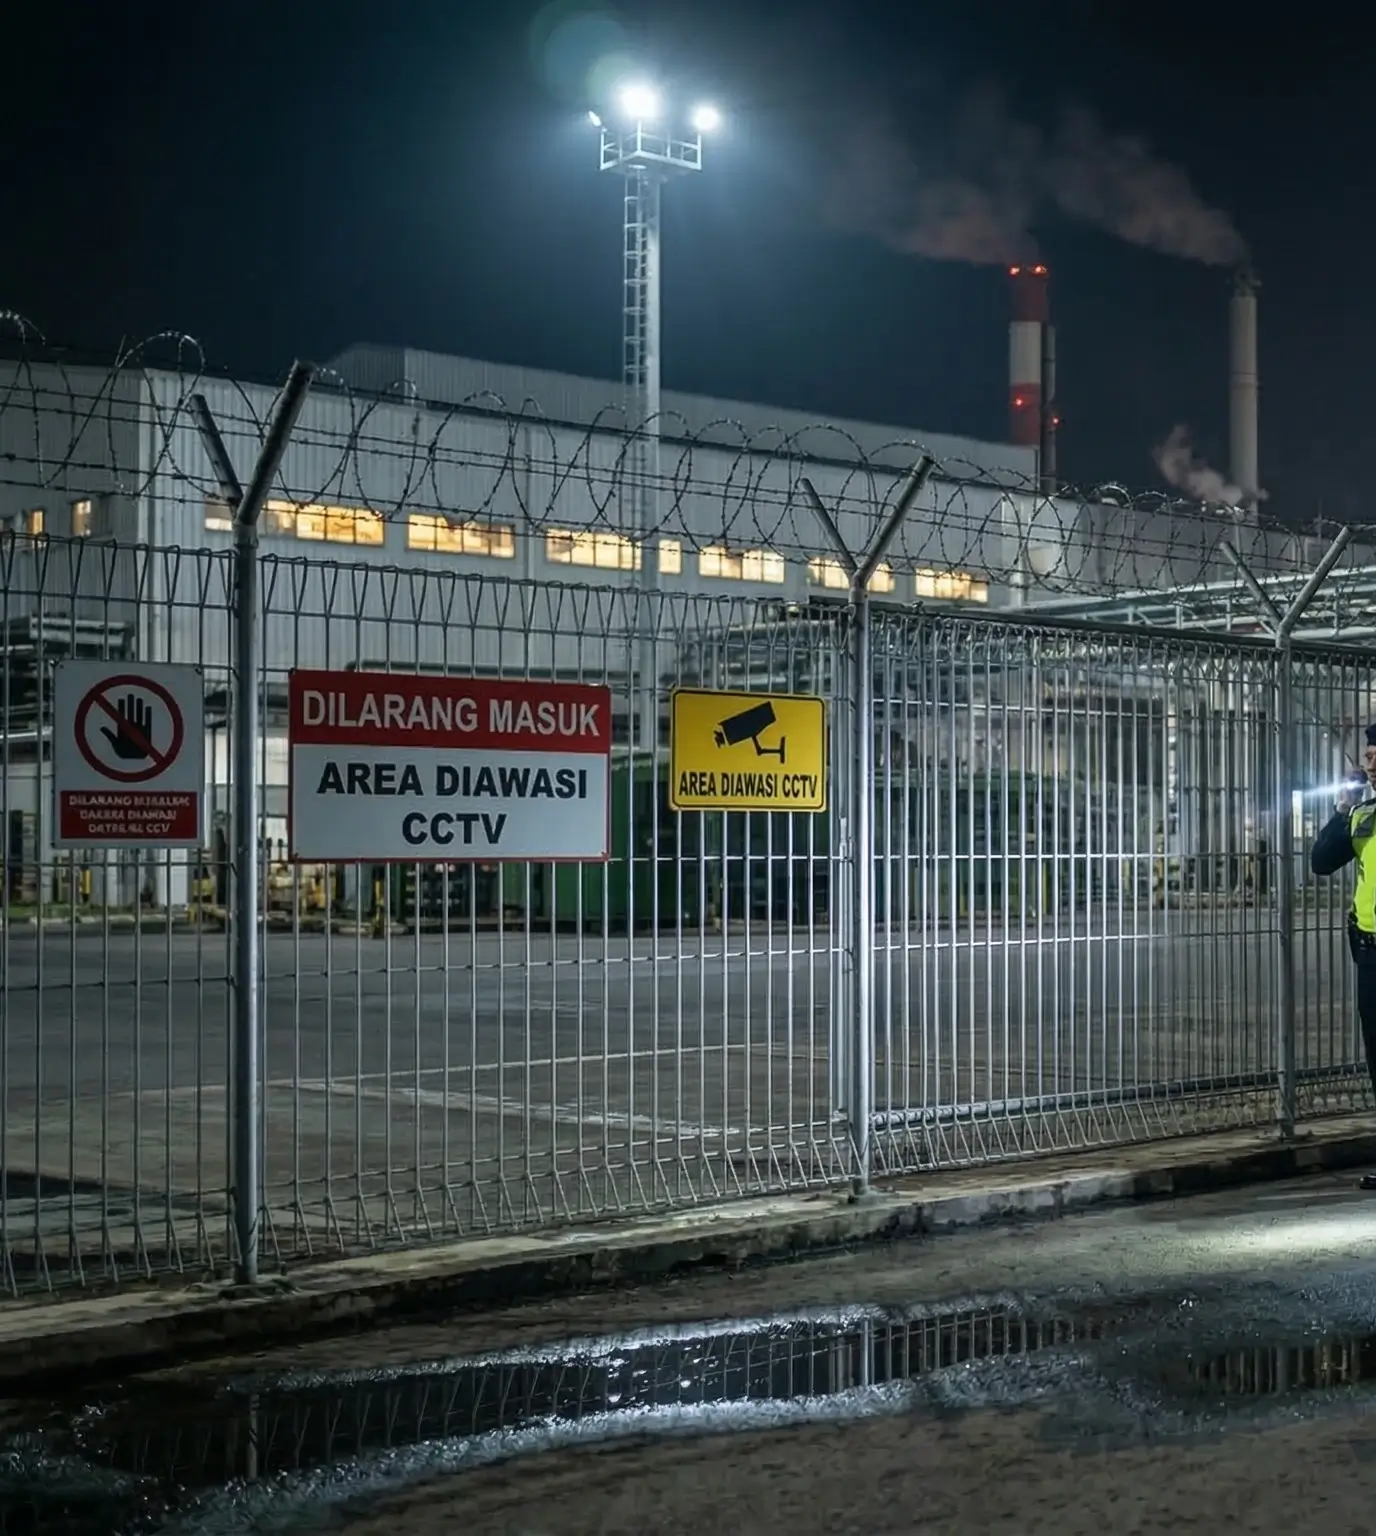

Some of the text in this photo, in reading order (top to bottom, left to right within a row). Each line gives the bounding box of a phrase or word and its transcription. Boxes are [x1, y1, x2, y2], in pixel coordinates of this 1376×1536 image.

[303, 690, 600, 737] DILARANG MASUK
[316, 762, 588, 799] AREA DIAWASI
[679, 770, 817, 798] AREA DIAWASI CCTV
[402, 812, 507, 845] CCTV
